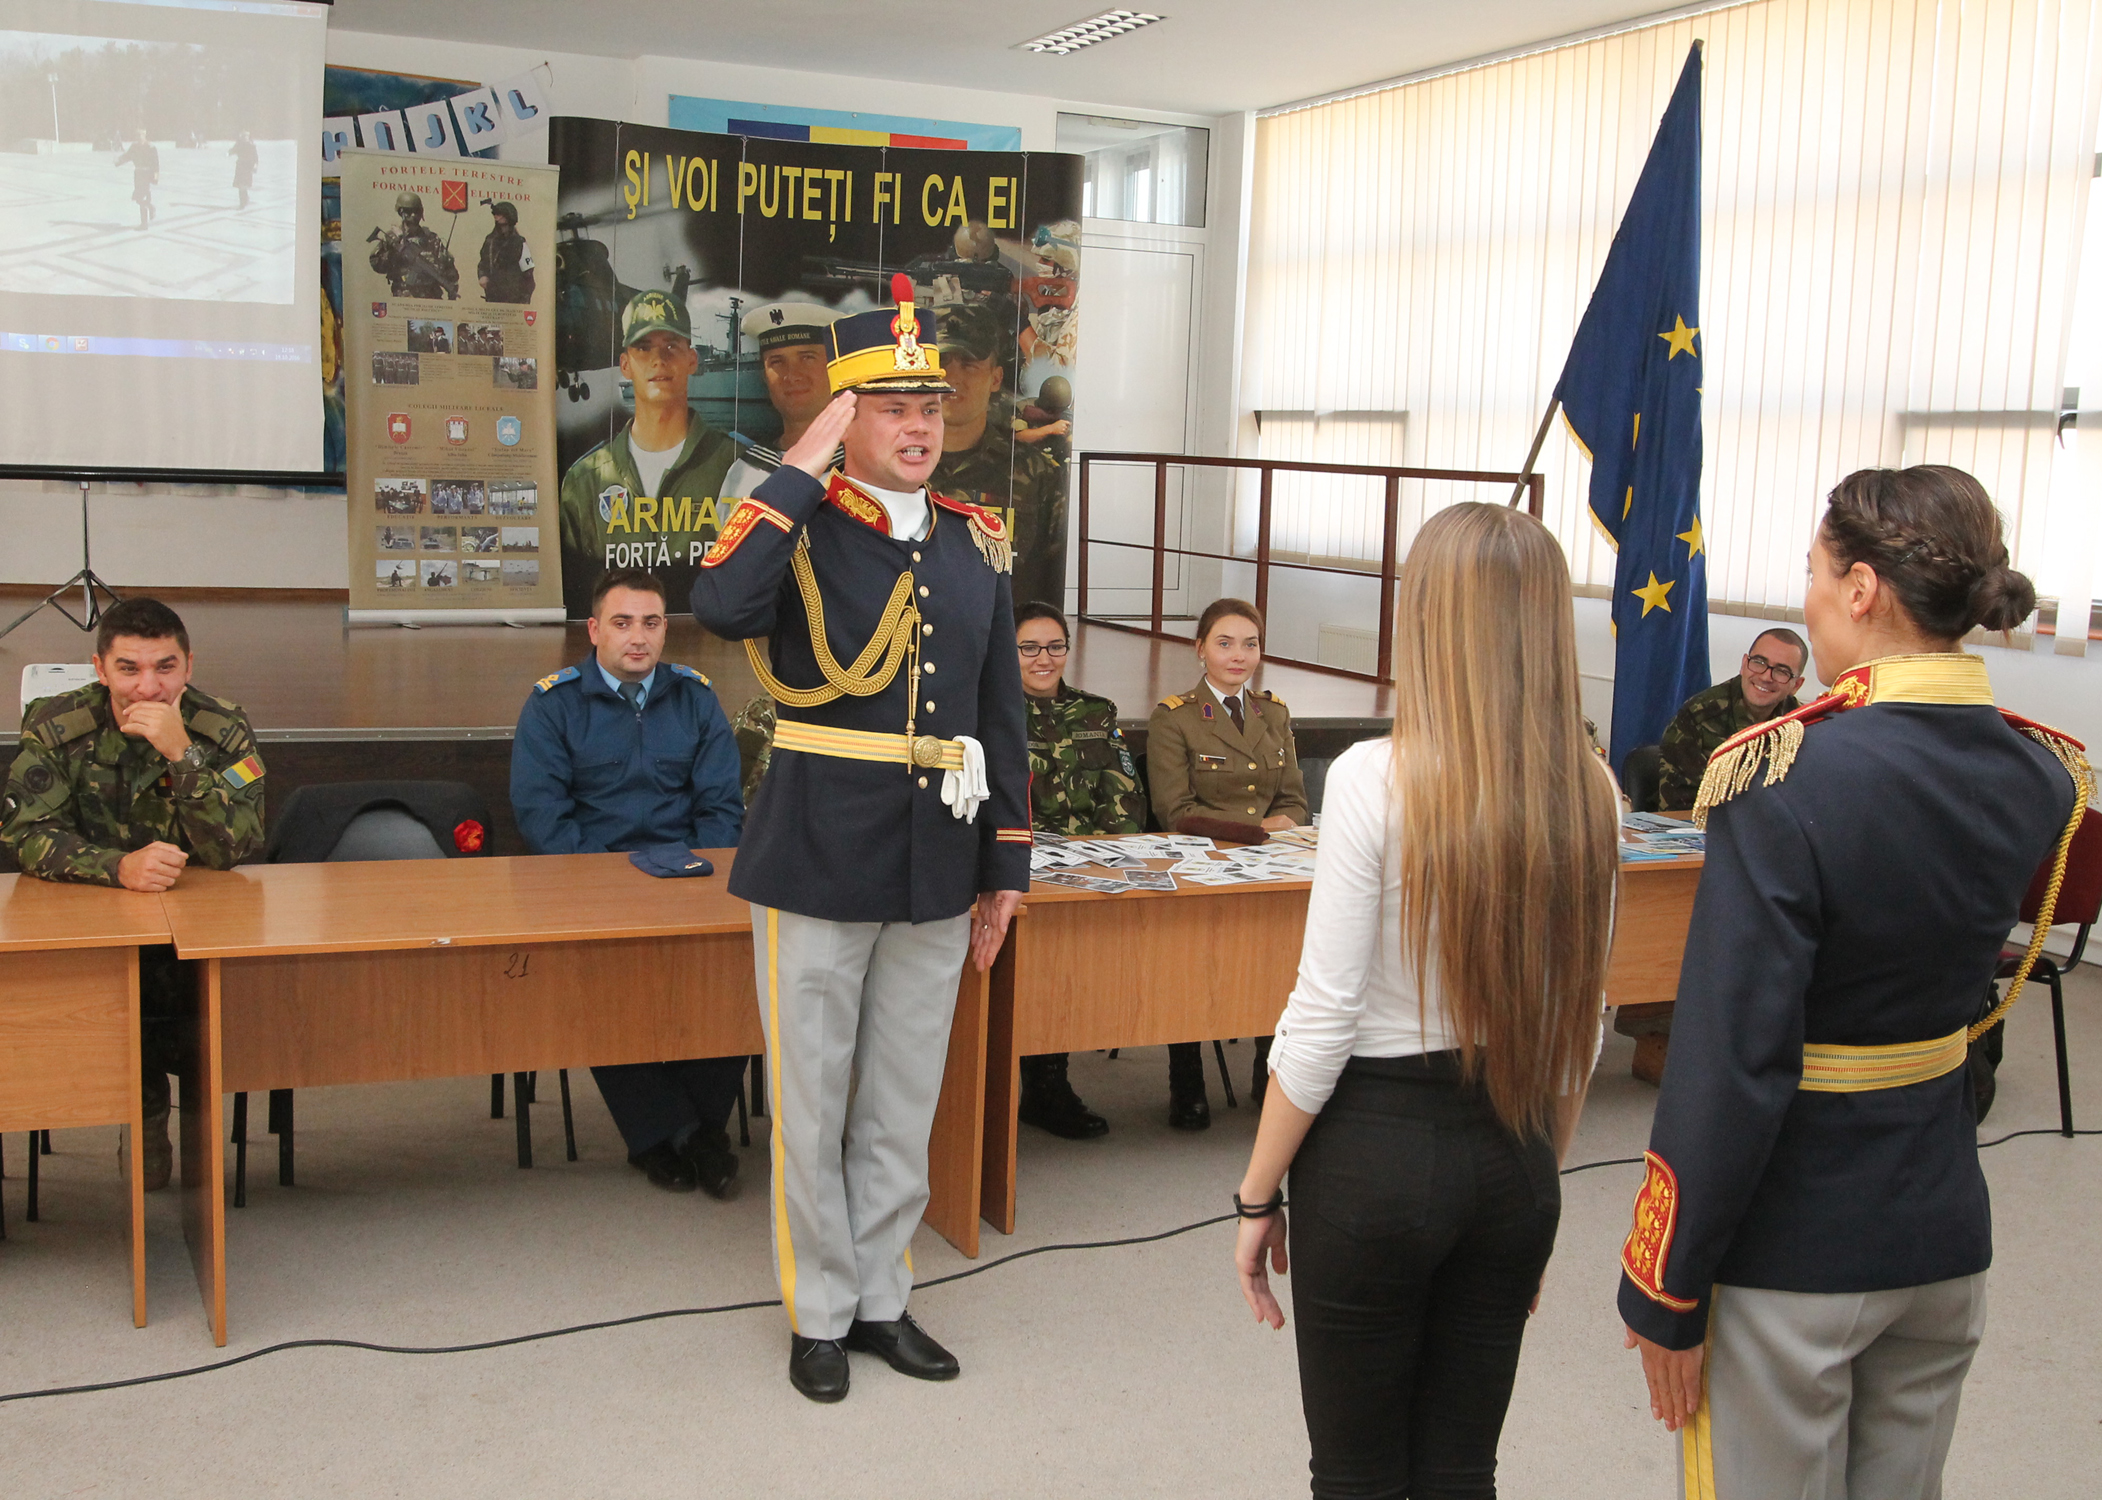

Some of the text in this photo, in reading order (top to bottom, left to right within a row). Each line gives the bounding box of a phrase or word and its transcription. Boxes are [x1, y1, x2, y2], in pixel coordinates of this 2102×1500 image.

[453, 168, 524, 187] TERESTRE
[372, 181, 531, 202] FORMAREA ELITELOR
[665, 154, 718, 212] VOI
[873, 172, 902, 225] FI
[921, 173, 969, 227] CA
[988, 177, 1018, 229] EI
